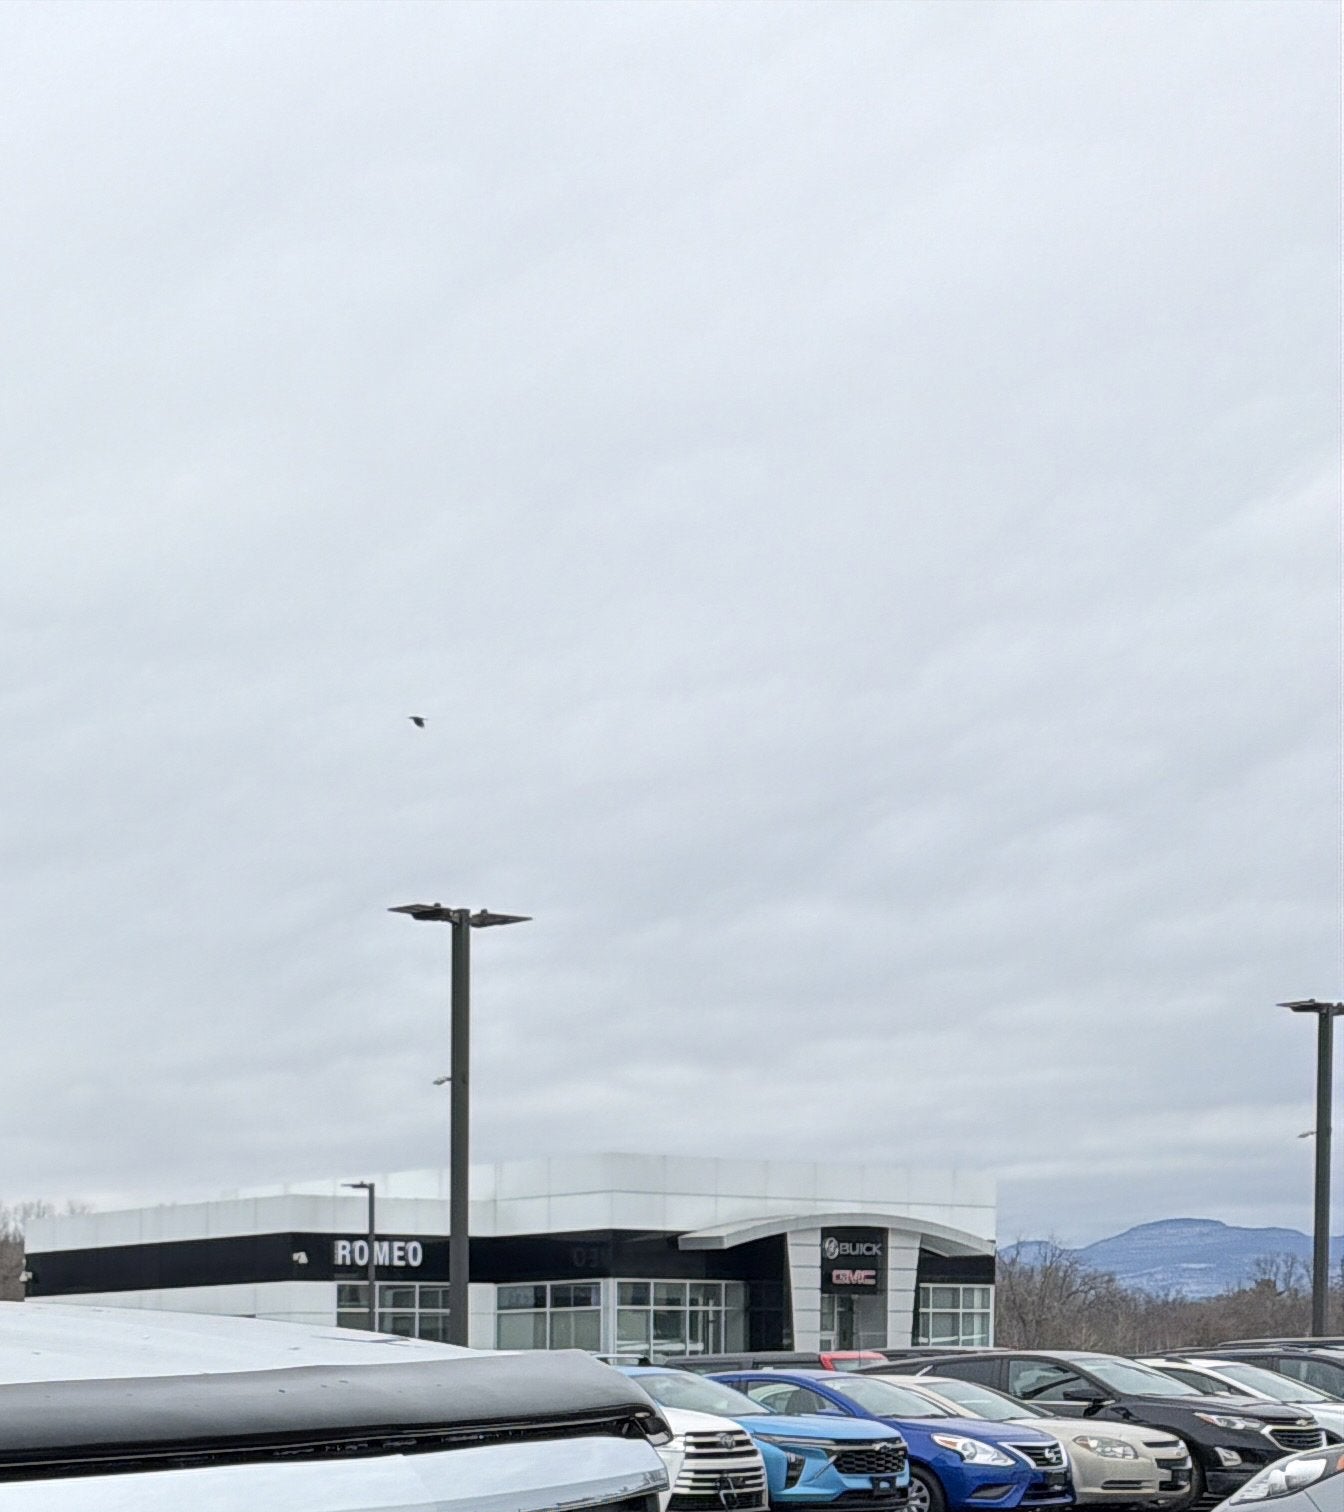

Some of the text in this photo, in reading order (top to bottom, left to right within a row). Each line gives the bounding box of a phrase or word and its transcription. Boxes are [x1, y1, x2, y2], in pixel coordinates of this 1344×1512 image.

[334, 1239, 423, 1267] ROMEO
[839, 1242, 882, 1256] BUICK
[832, 1269, 876, 1285] GMC
